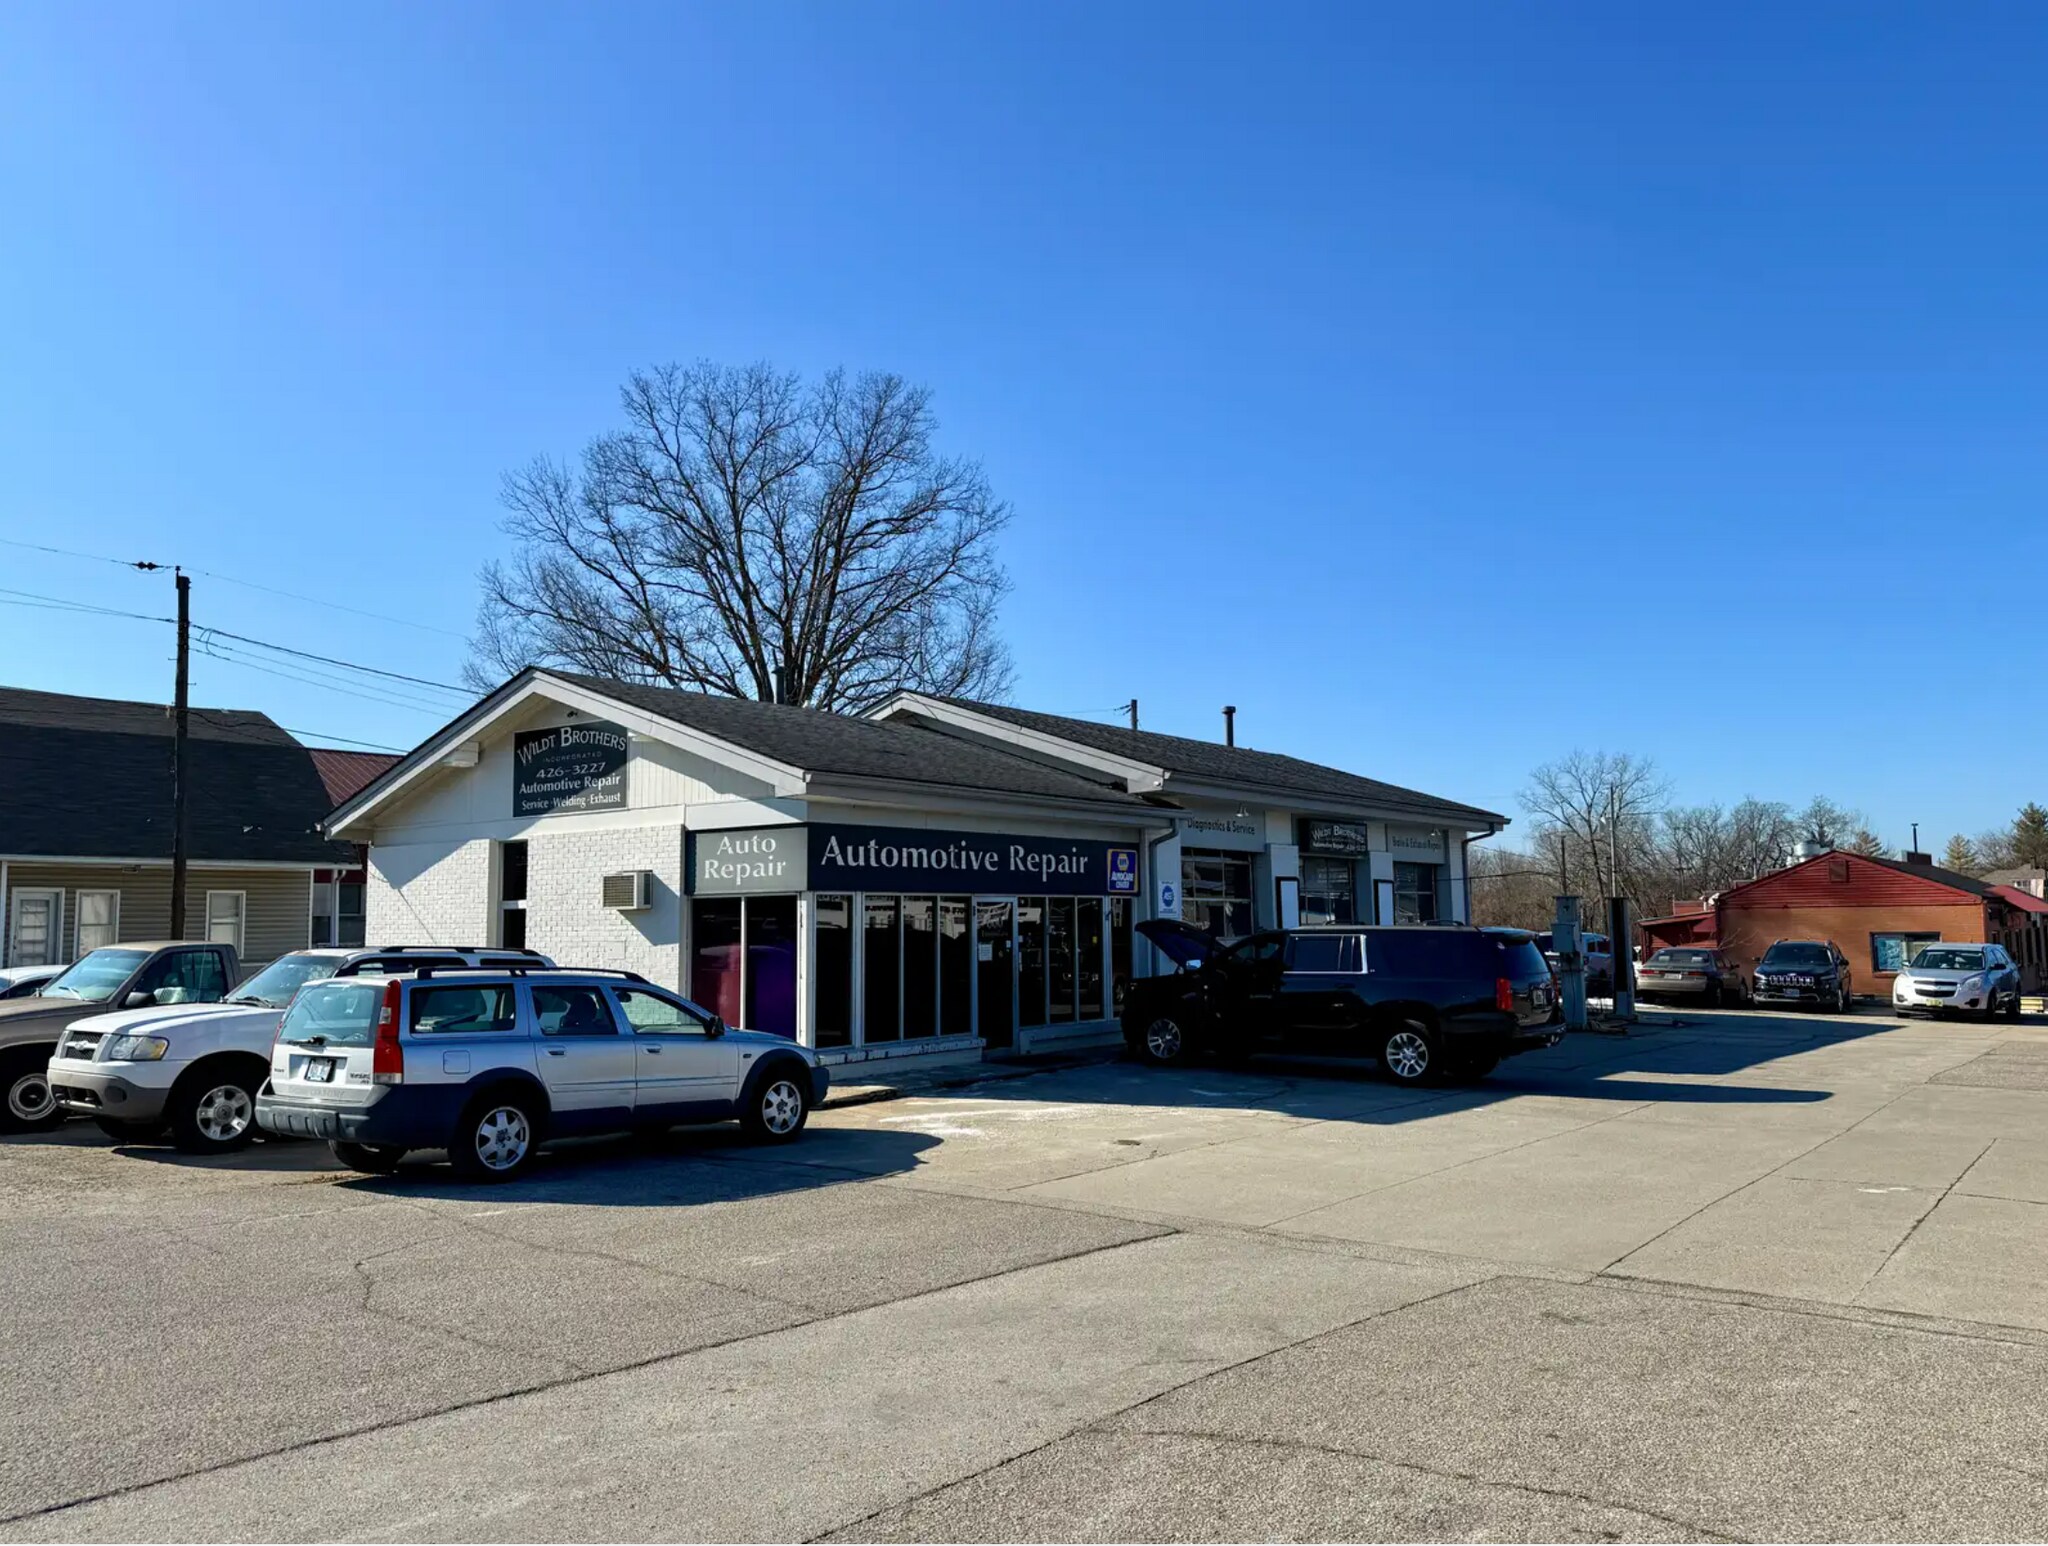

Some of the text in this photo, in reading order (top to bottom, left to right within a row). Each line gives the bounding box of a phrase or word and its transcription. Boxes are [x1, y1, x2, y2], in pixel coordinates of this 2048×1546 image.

[516, 726, 627, 766] WILDT BROTHERS
[536, 762, 606, 778] 426-3227
[519, 773, 621, 794] Automotive Repair
[522, 792, 621, 811] Service Welding Exhaust
[1188, 818, 1225, 832] Diagnostics
[1232, 820, 1256, 835] Service
[717, 834, 776, 855] Auto
[820, 835, 1089, 882] Automotive Repair
[704, 855, 786, 885] Repair
